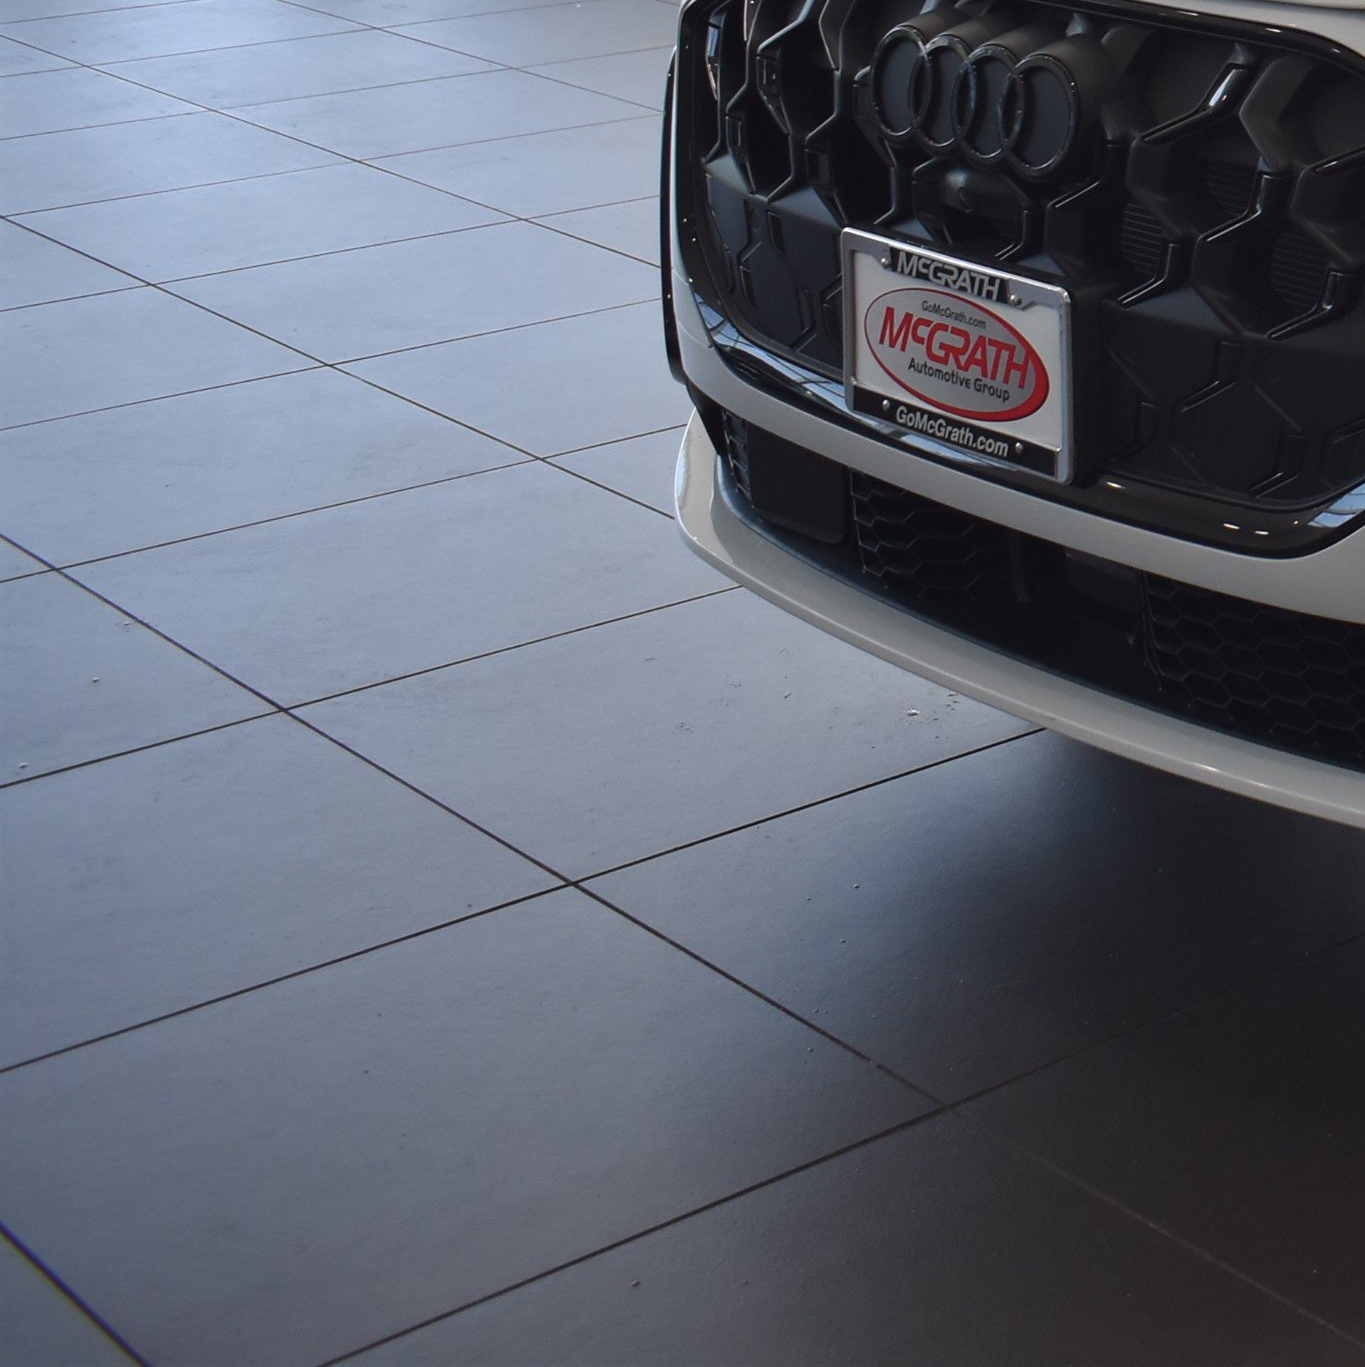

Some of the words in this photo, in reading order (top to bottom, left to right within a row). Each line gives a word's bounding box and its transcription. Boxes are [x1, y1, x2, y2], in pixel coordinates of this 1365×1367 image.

[921, 299, 987, 330] GoMcGrath.com
[907, 356, 971, 389] Automotive
[973, 373, 1010, 403] Group
[896, 405, 1009, 458] GoMcGrath.com
